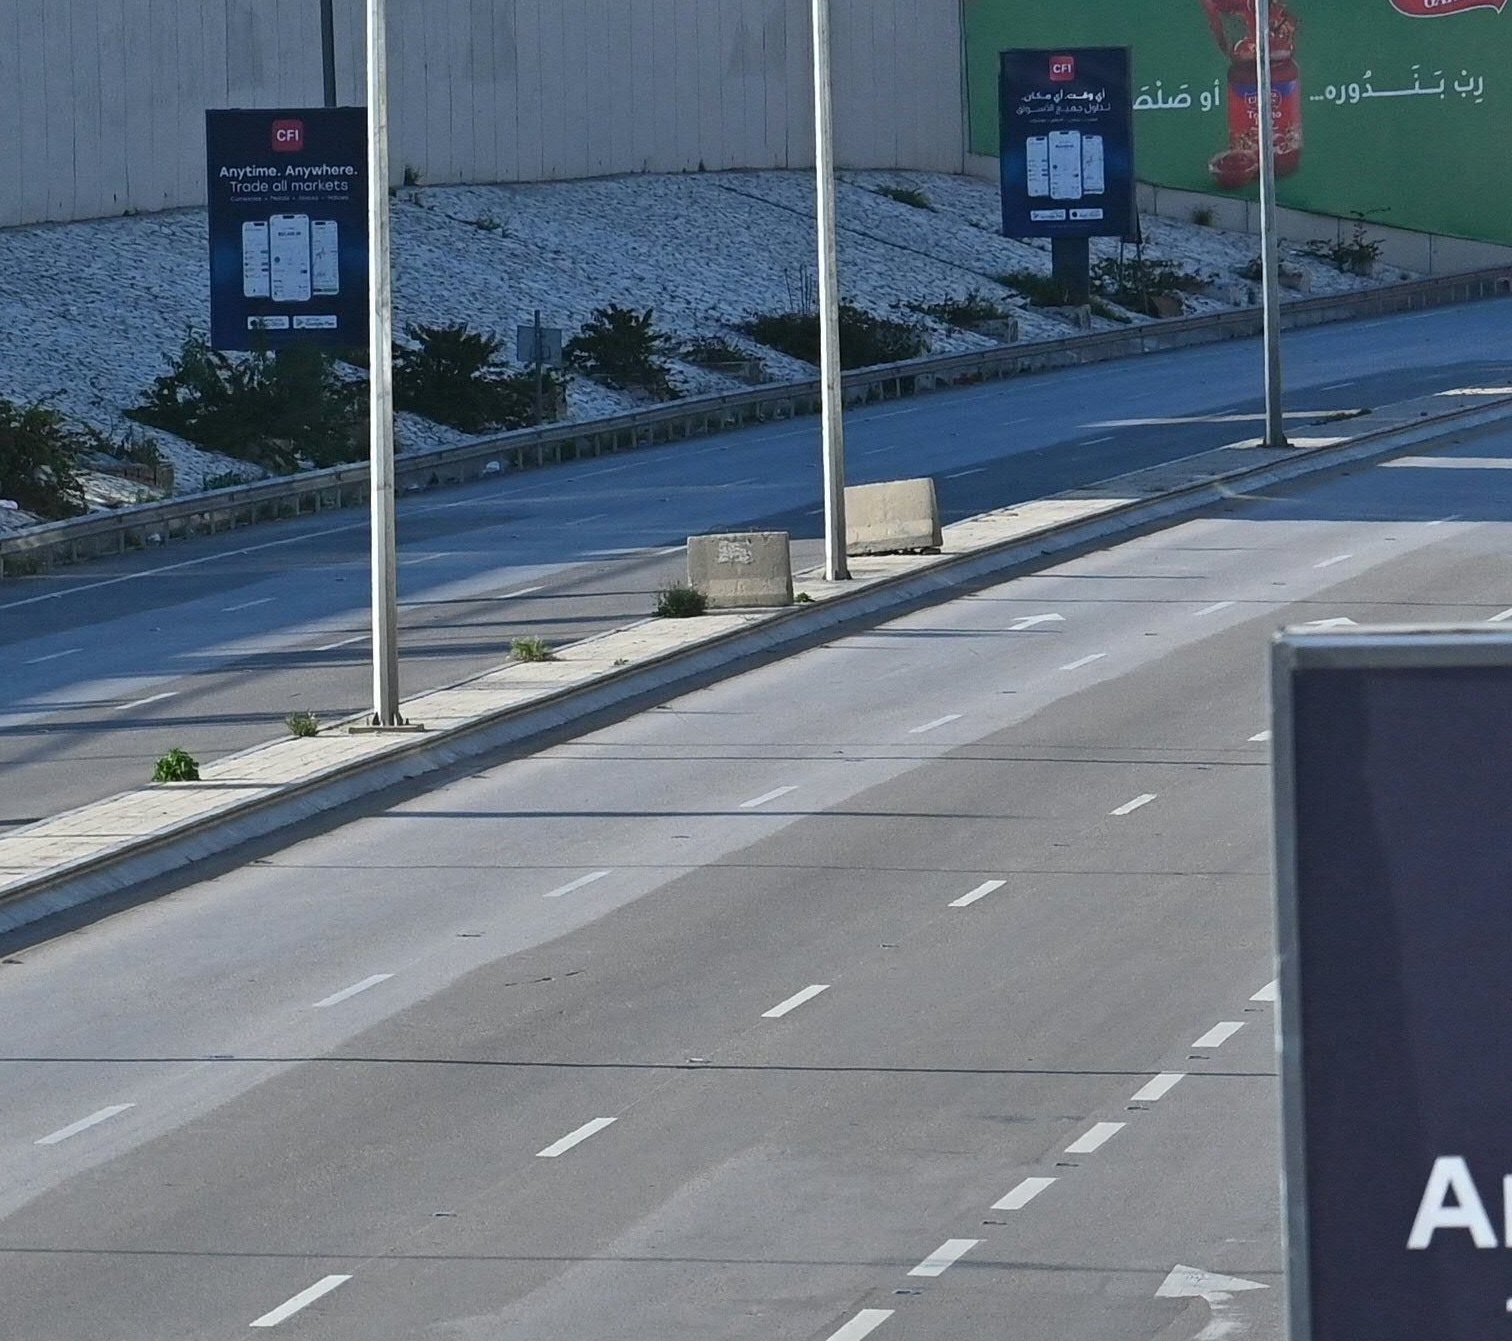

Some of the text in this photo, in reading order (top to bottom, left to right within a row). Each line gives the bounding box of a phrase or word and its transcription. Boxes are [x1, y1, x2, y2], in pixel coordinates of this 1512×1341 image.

[1052, 64, 1072, 74] CFI
[276, 129, 299, 142] CFI
[219, 163, 358, 180] Anytime. Anywhere.
[230, 179, 348, 193] Trade all markets
[1407, 1155, 1512, 1250] A
